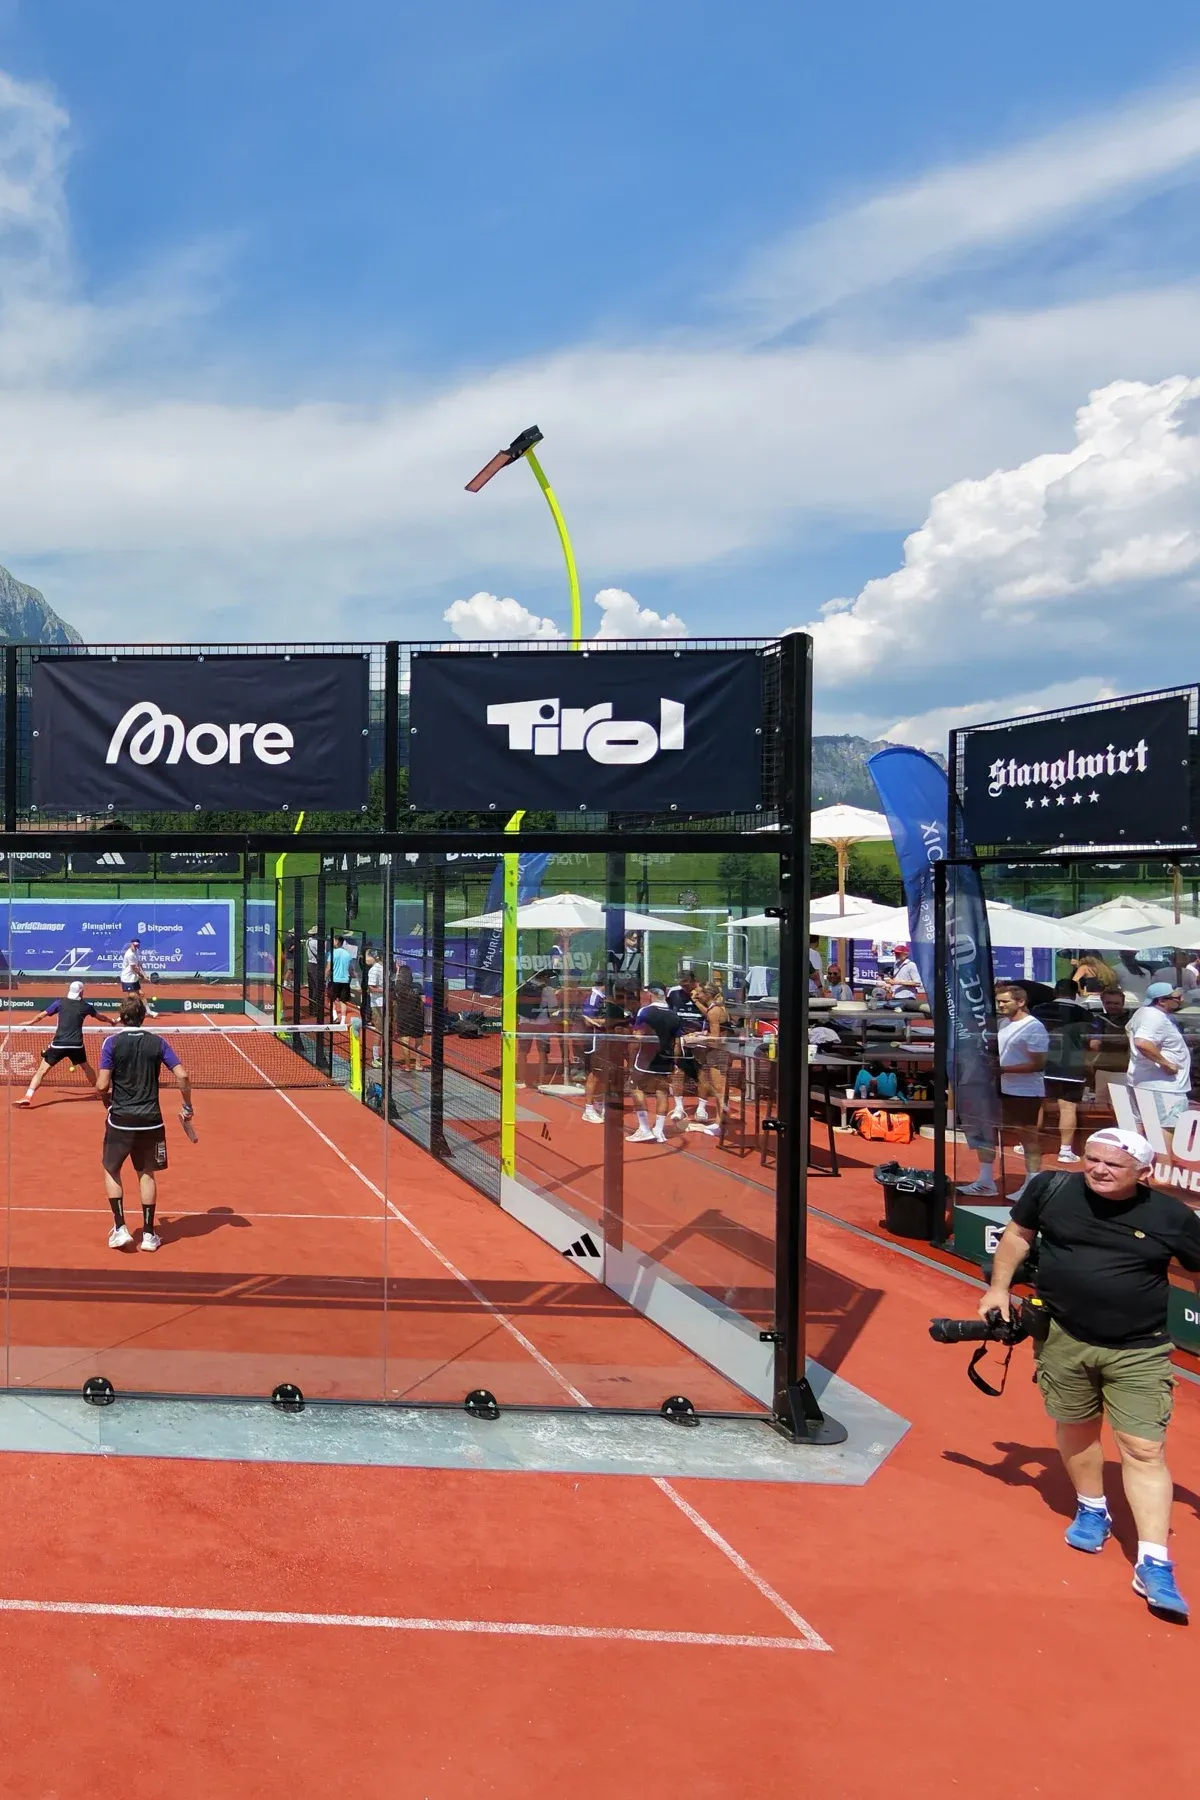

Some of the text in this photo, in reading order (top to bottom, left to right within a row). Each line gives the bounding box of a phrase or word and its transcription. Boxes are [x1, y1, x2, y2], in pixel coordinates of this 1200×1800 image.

[106, 701, 294, 765] More
[487, 698, 685, 764] Tirol
[988, 738, 1149, 798] Stanglwirt
[148, 924, 183, 932] bitpanda
[481, 928, 503, 970] MAURIC
[3, 999, 34, 1008] bitpanda
[193, 1001, 224, 1010] bitpanda
